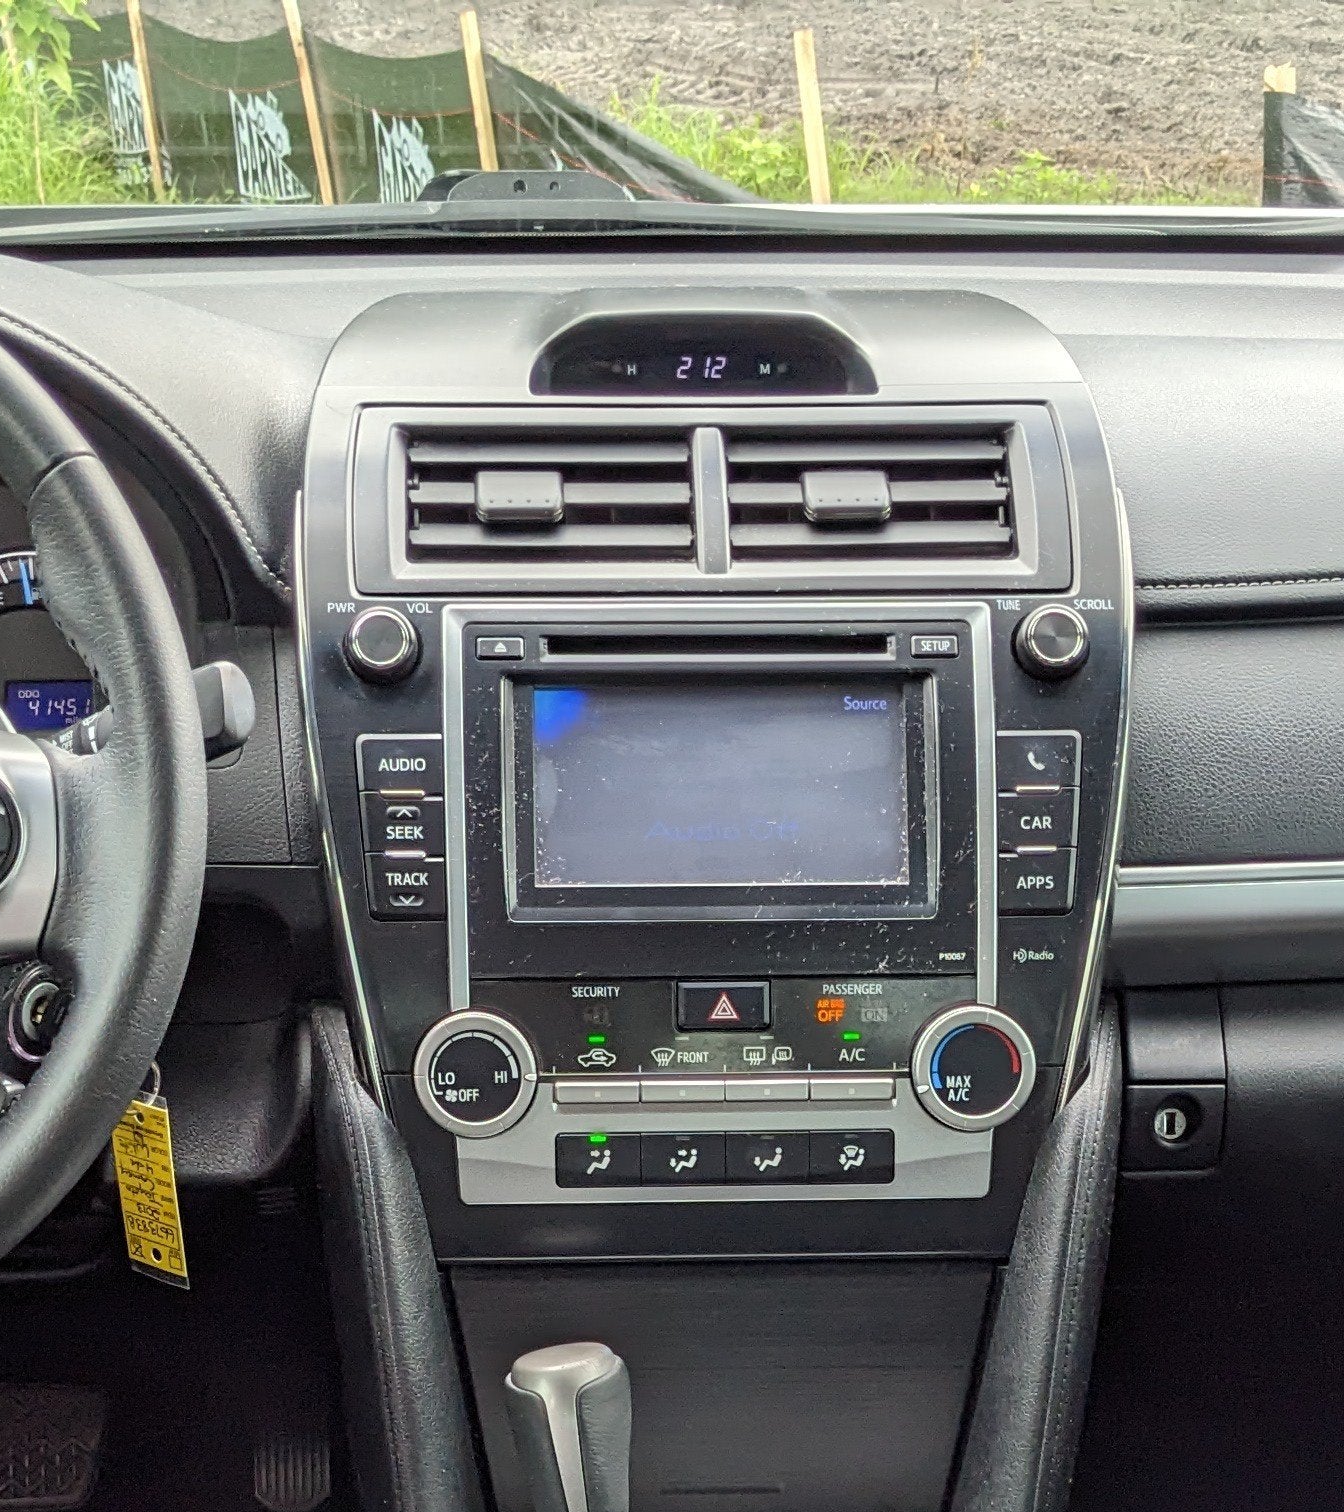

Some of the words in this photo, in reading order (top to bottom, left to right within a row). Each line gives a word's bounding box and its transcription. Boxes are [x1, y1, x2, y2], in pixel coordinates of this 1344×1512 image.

[627, 364, 637, 376] H
[759, 363, 771, 375] M
[327, 602, 356, 614] PWR
[406, 603, 434, 614] VOL
[997, 599, 1021, 611] TUNE
[1073, 600, 1115, 611] SCROLL
[920, 639, 951, 652] SETUP
[17, 690, 40, 699] ODO
[843, 695, 888, 711] Source
[378, 757, 427, 772] AUDIO
[1020, 816, 1053, 830] CAR
[386, 826, 424, 840] SEEK
[386, 872, 429, 886] TRACK
[1016, 876, 1054, 890] APPS
[1029, 951, 1054, 960] Radio
[572, 986, 620, 998] SECURITY
[822, 983, 883, 995] PASSENGER
[817, 1009, 843, 1022] OFF
[677, 1052, 709, 1063] FRONT
[838, 1048, 866, 1061] A/C
[438, 1072, 455, 1085] LO
[494, 1071, 508, 1084] HI
[946, 1075, 972, 1088] MAX
[458, 1089, 480, 1102] OFF
[947, 1088, 970, 1102] A/C
